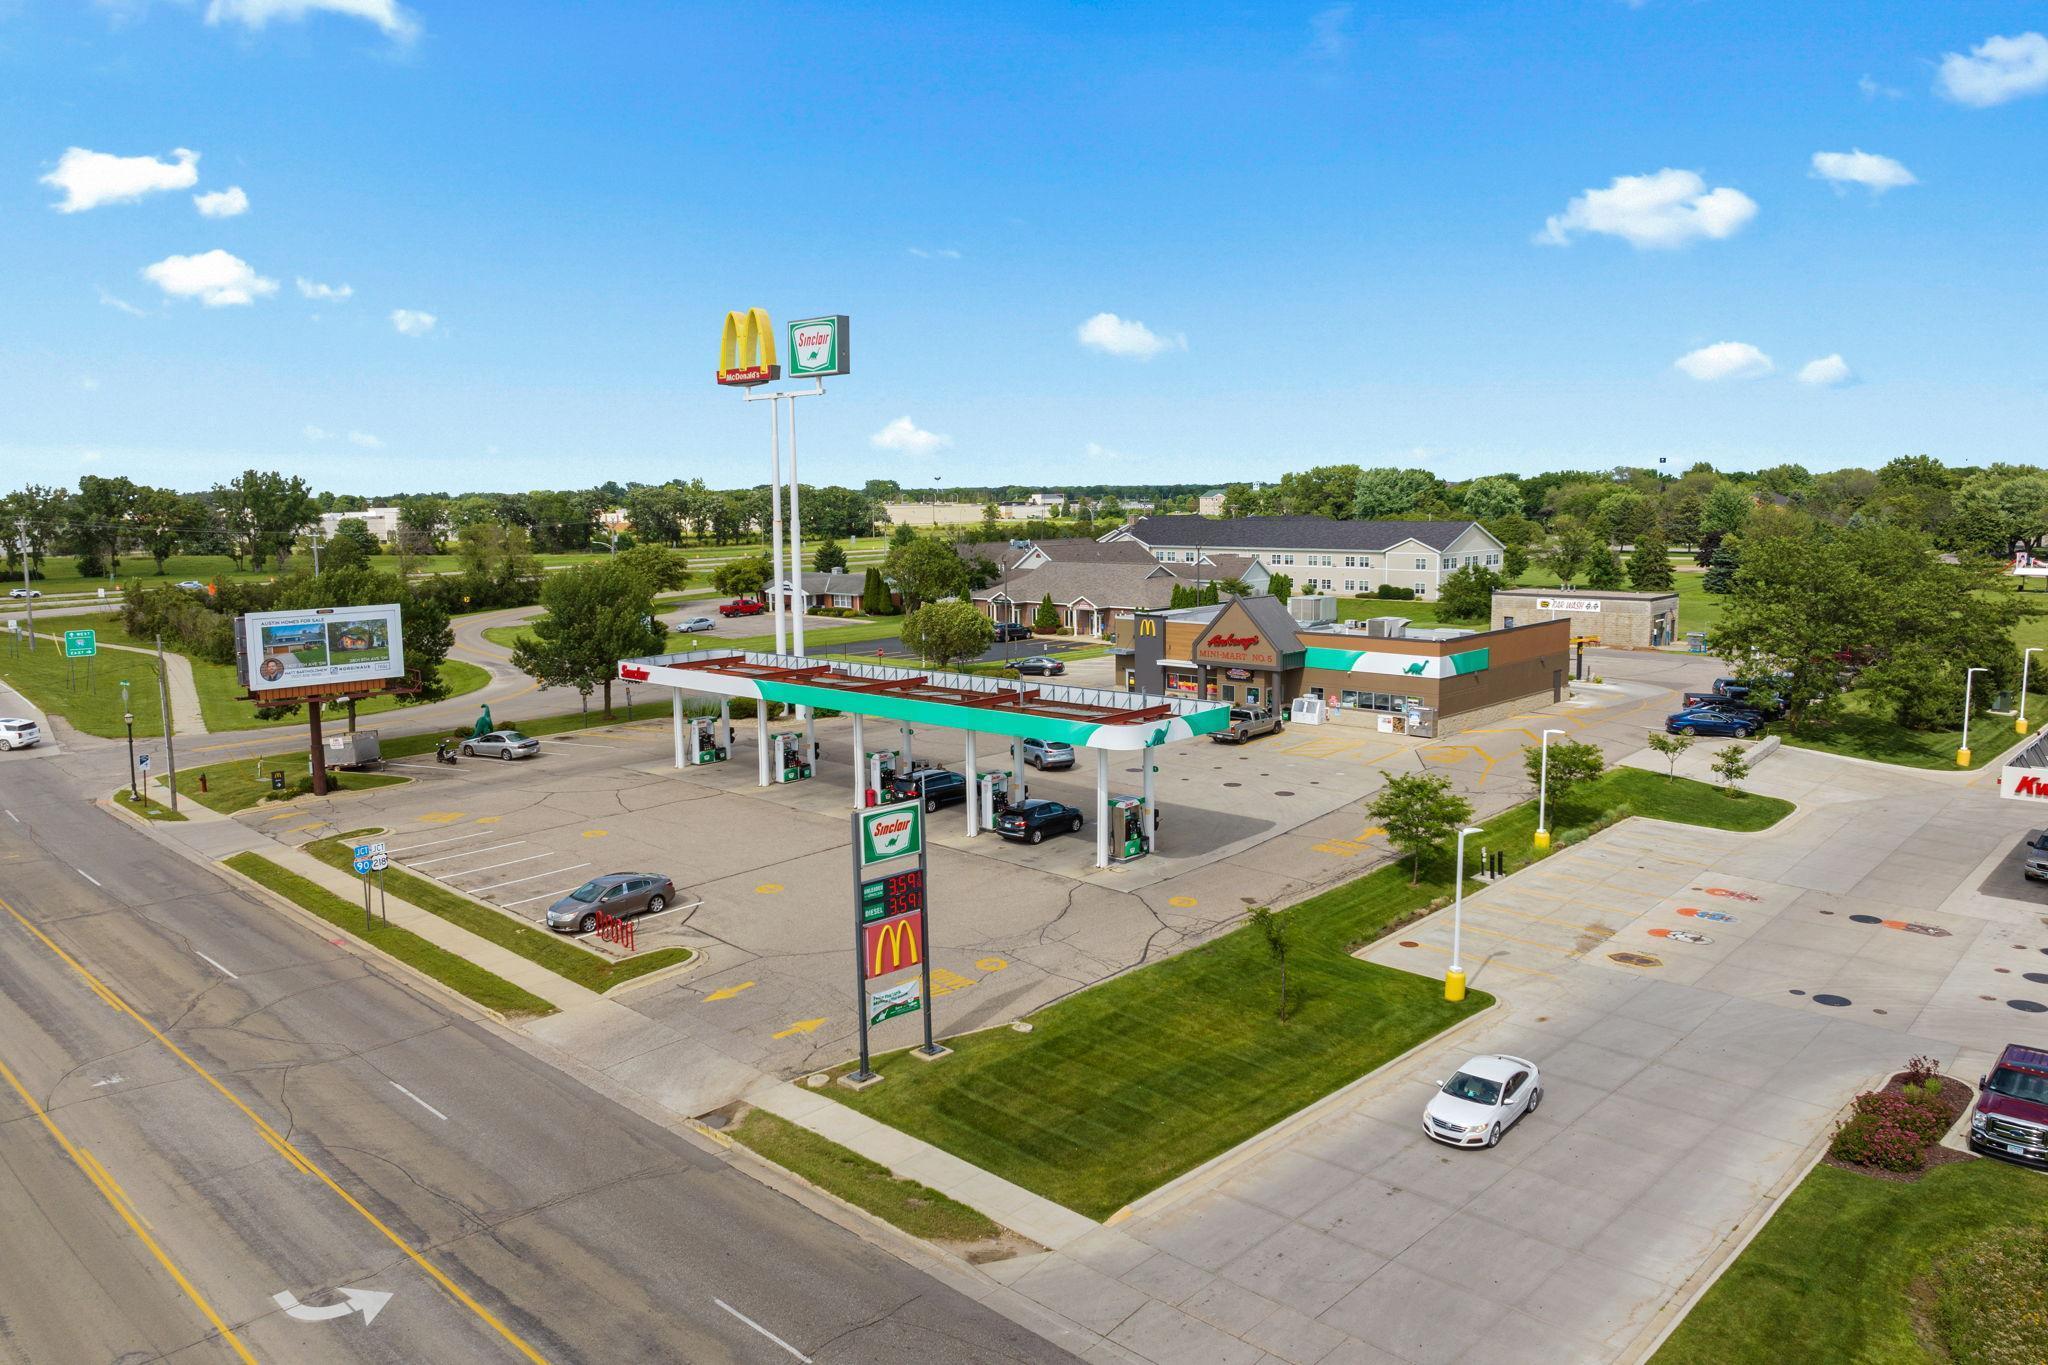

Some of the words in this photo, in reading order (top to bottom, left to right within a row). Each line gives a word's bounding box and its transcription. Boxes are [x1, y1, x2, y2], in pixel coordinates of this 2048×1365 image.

[798, 331, 829, 347] Sinclair
[725, 371, 760, 381] McDonald's
[1199, 650, 1248, 661] MINI-MART
[874, 819, 910, 837] Sinclair
[356, 847, 368, 856] JCT
[372, 844, 384, 852] JCT
[357, 861, 370, 870] 90
[373, 858, 386, 867] 218
[864, 907, 884, 918] DIESEL
